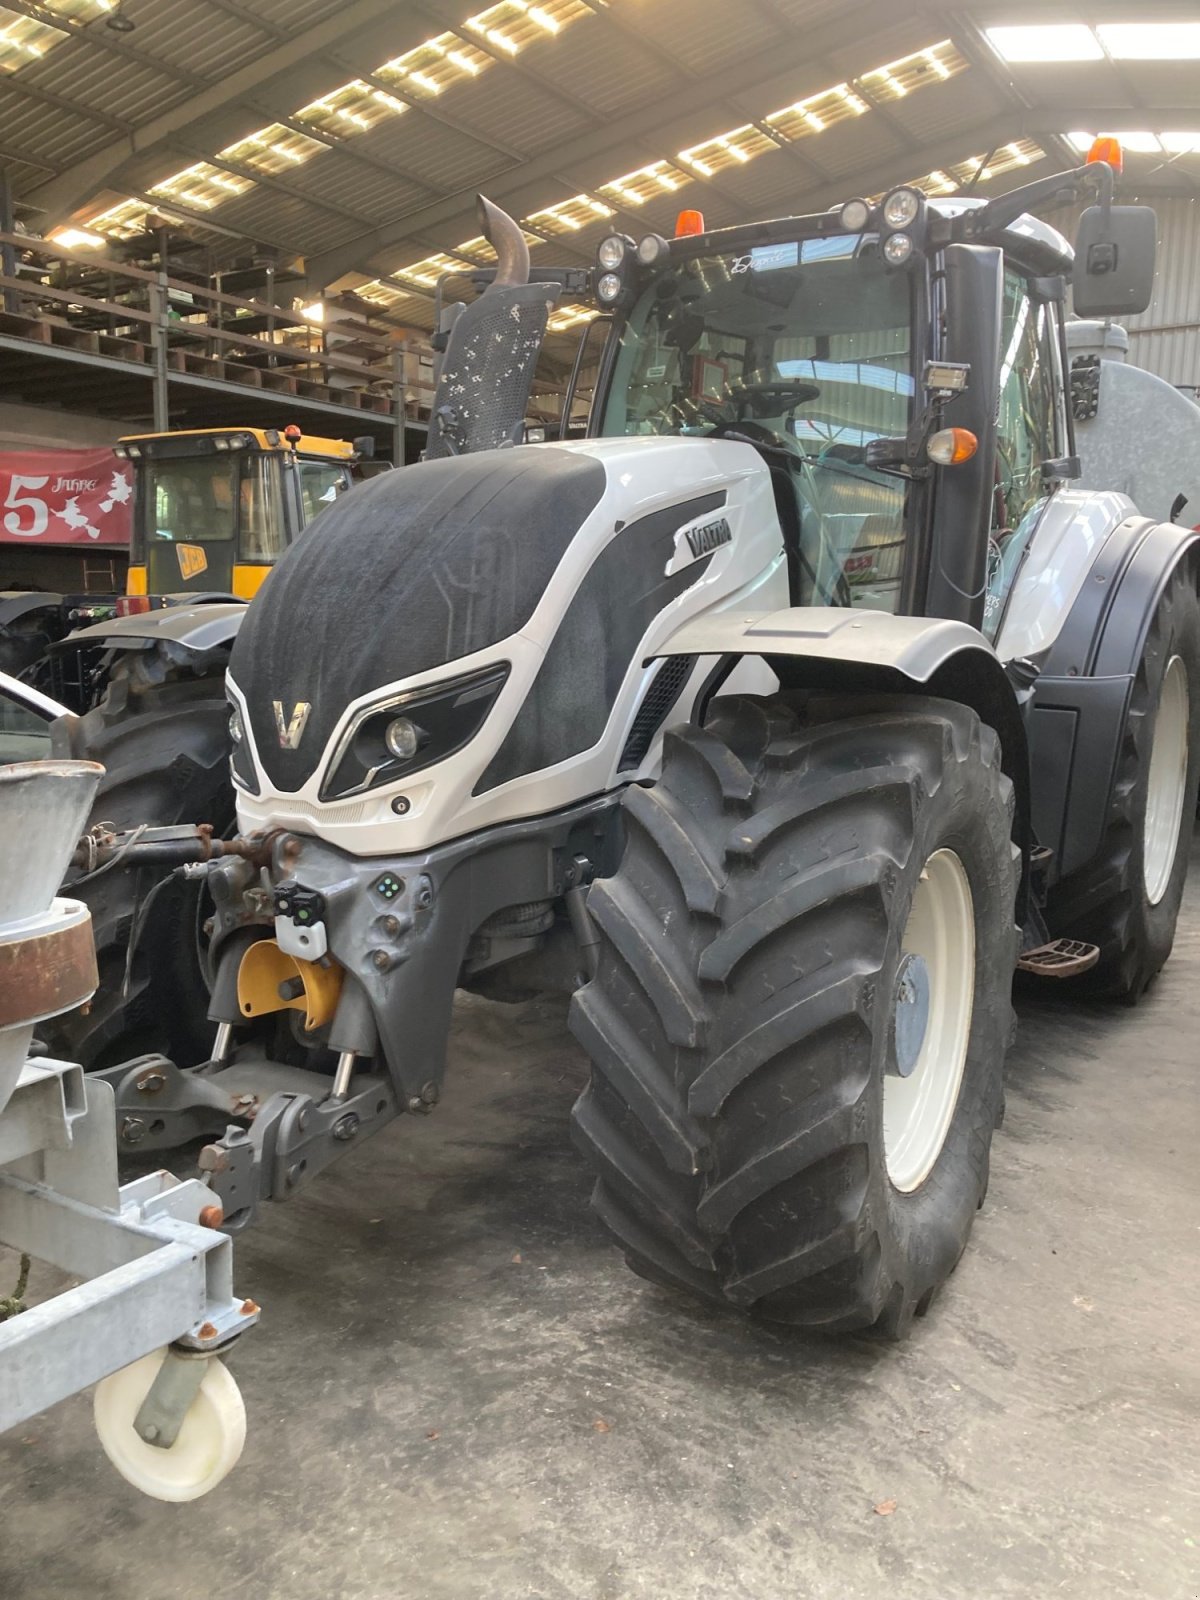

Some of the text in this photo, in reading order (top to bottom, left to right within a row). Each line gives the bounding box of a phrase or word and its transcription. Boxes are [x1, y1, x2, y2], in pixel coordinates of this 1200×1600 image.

[4, 475, 49, 537] 5
[685, 518, 732, 558] VALTRA
[179, 547, 206, 577] JCB
